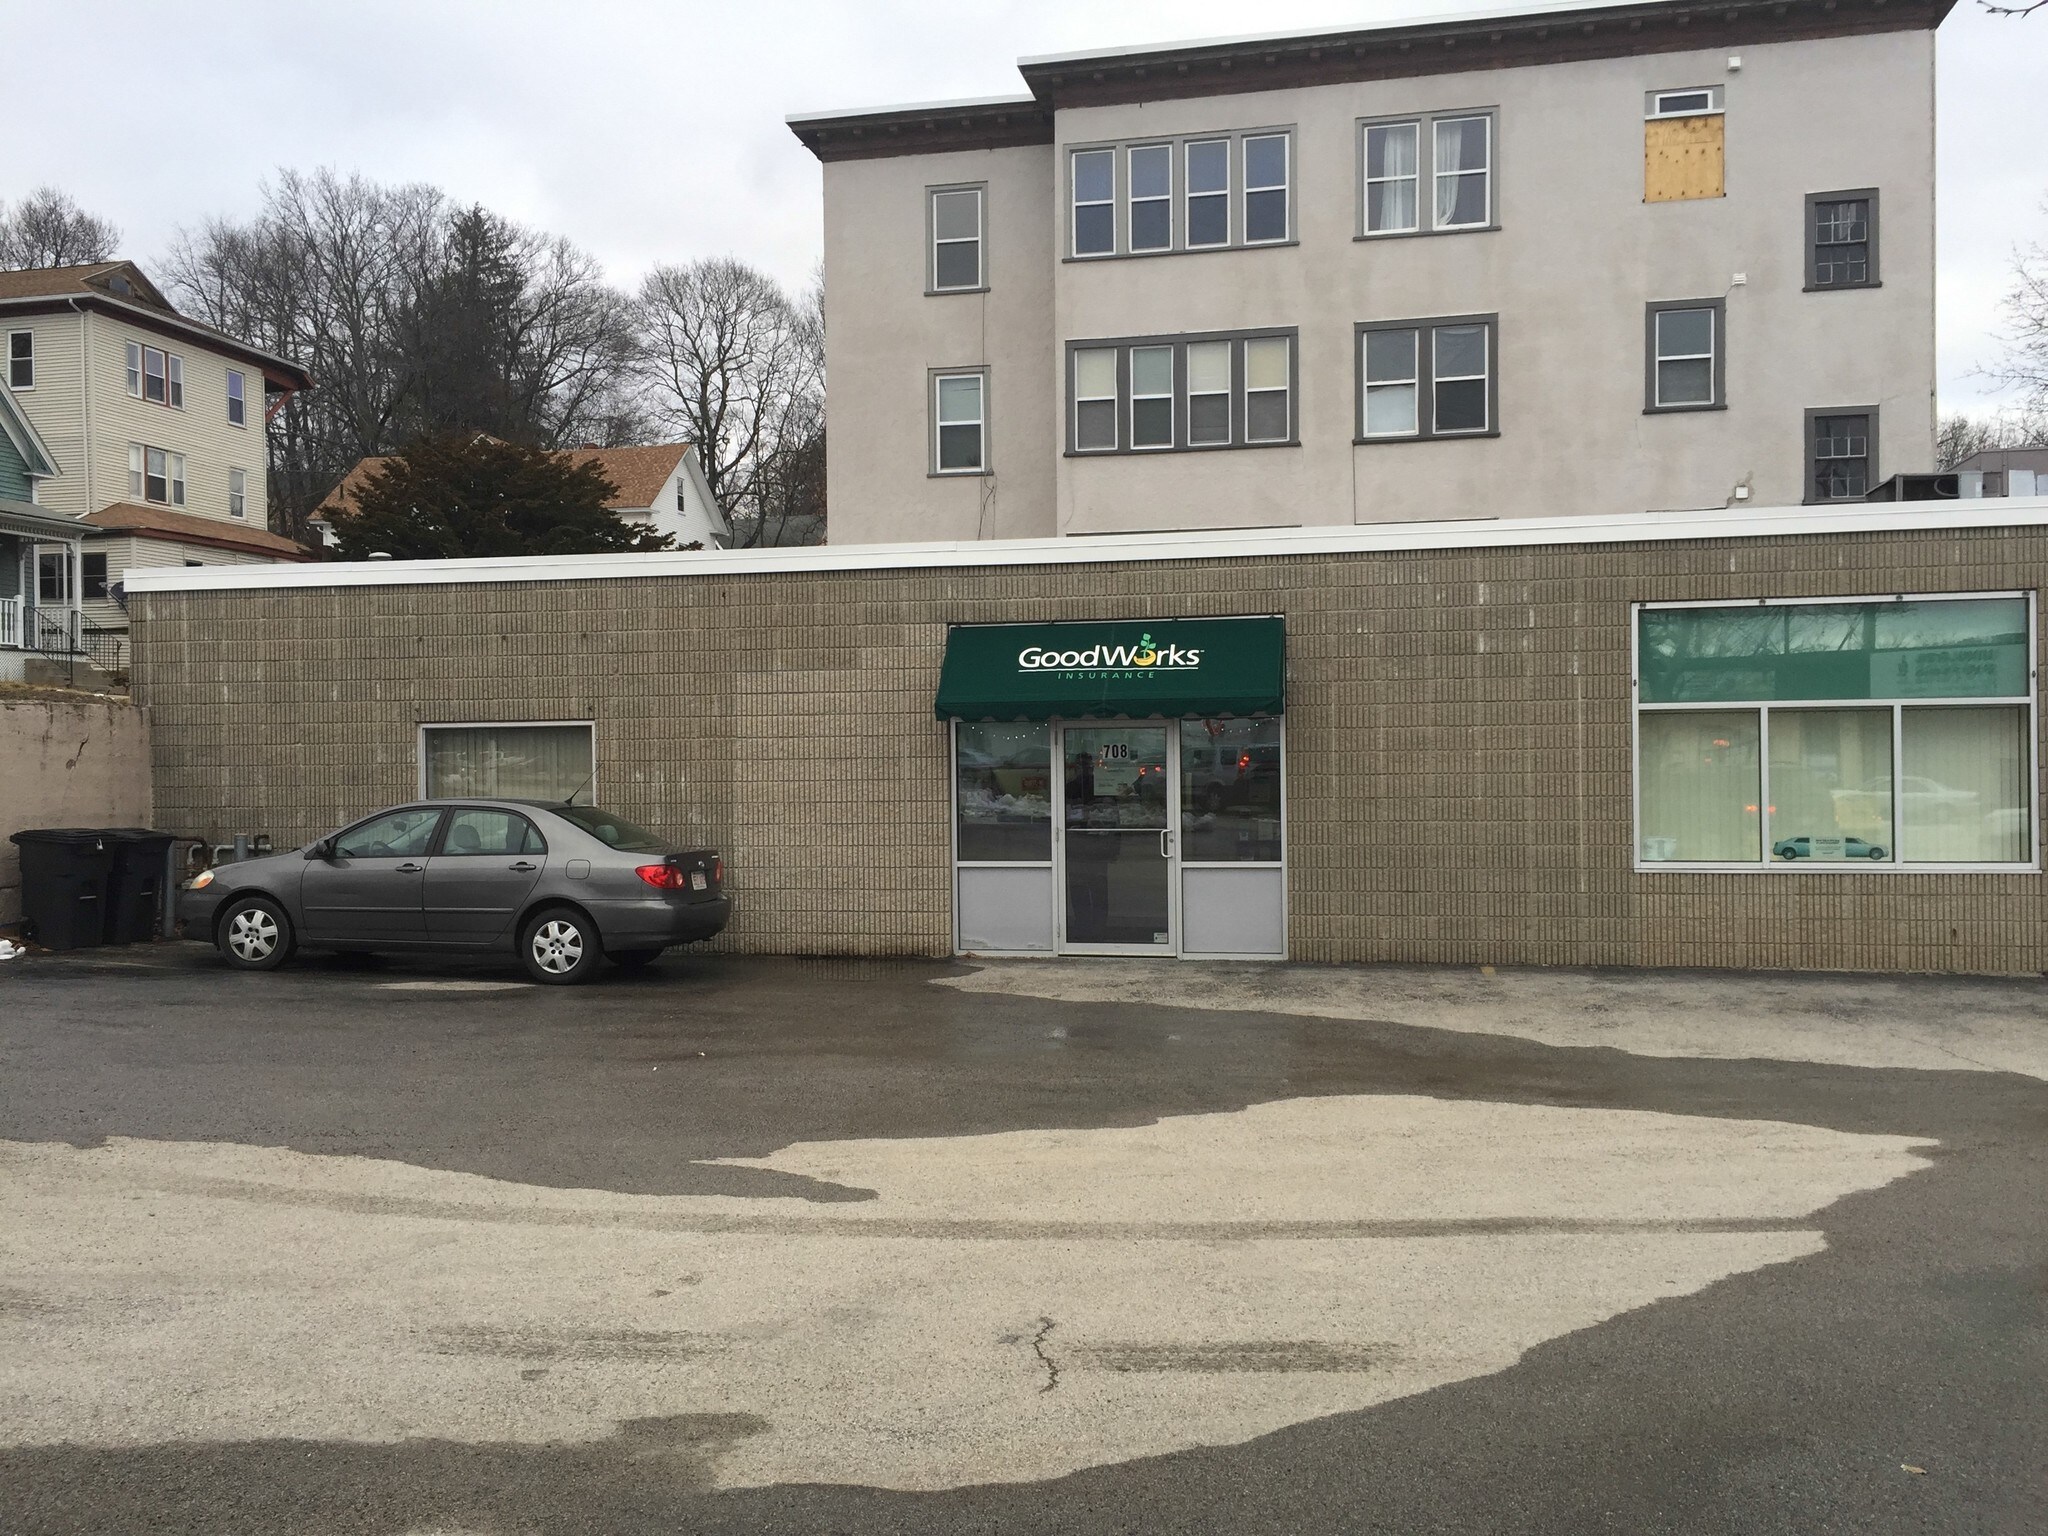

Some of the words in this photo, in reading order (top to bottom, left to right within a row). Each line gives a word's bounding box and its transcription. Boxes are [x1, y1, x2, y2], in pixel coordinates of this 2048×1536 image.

[1018, 644, 1200, 667] GoodWorks
[1057, 671, 1155, 679] INSURANCE
[1103, 744, 1127, 758] 708
